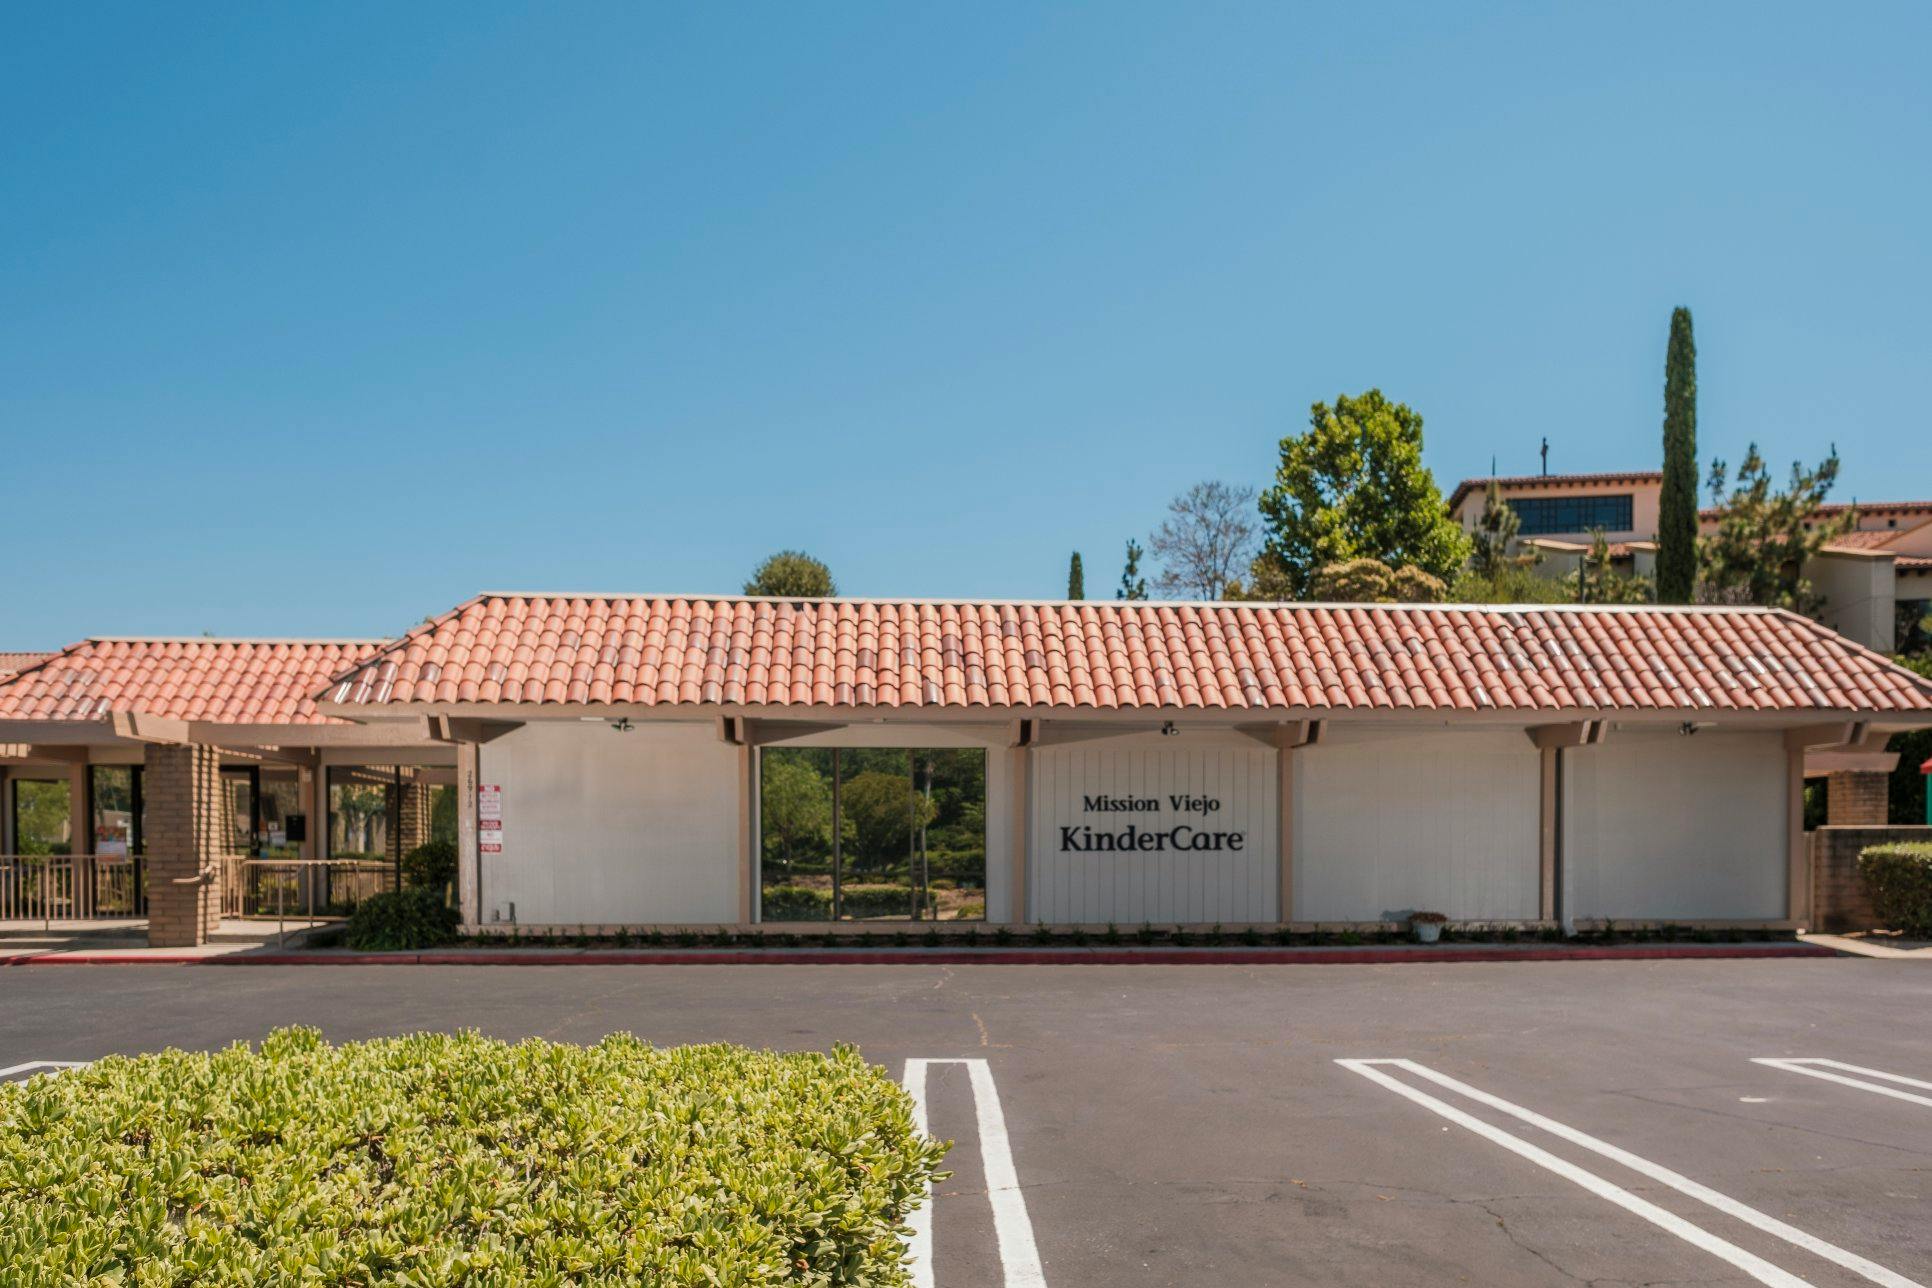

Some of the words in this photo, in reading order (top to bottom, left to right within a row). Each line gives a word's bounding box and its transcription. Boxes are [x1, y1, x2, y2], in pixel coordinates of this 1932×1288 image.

[1083, 795, 1160, 812] Mission
[1169, 795, 1220, 816] Viejo
[1060, 825, 1244, 851] KinderCare
